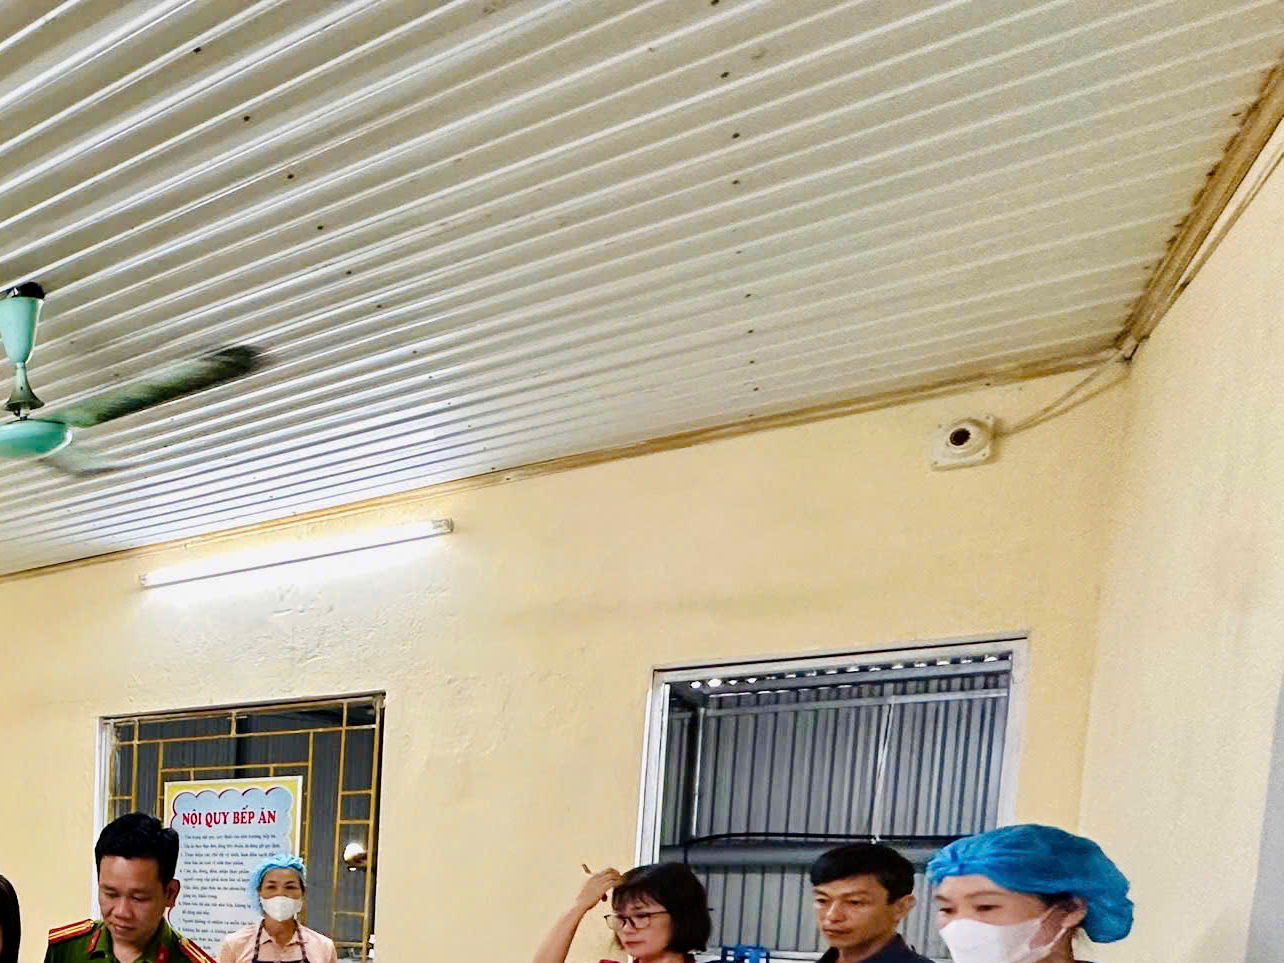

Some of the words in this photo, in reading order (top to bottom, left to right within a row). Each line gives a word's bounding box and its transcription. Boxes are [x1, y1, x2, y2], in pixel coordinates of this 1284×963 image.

[182, 809, 202, 828] NỘI
[205, 812, 230, 828] QUY
[232, 805, 255, 824] BẾP
[258, 807, 277, 824] ĂN
